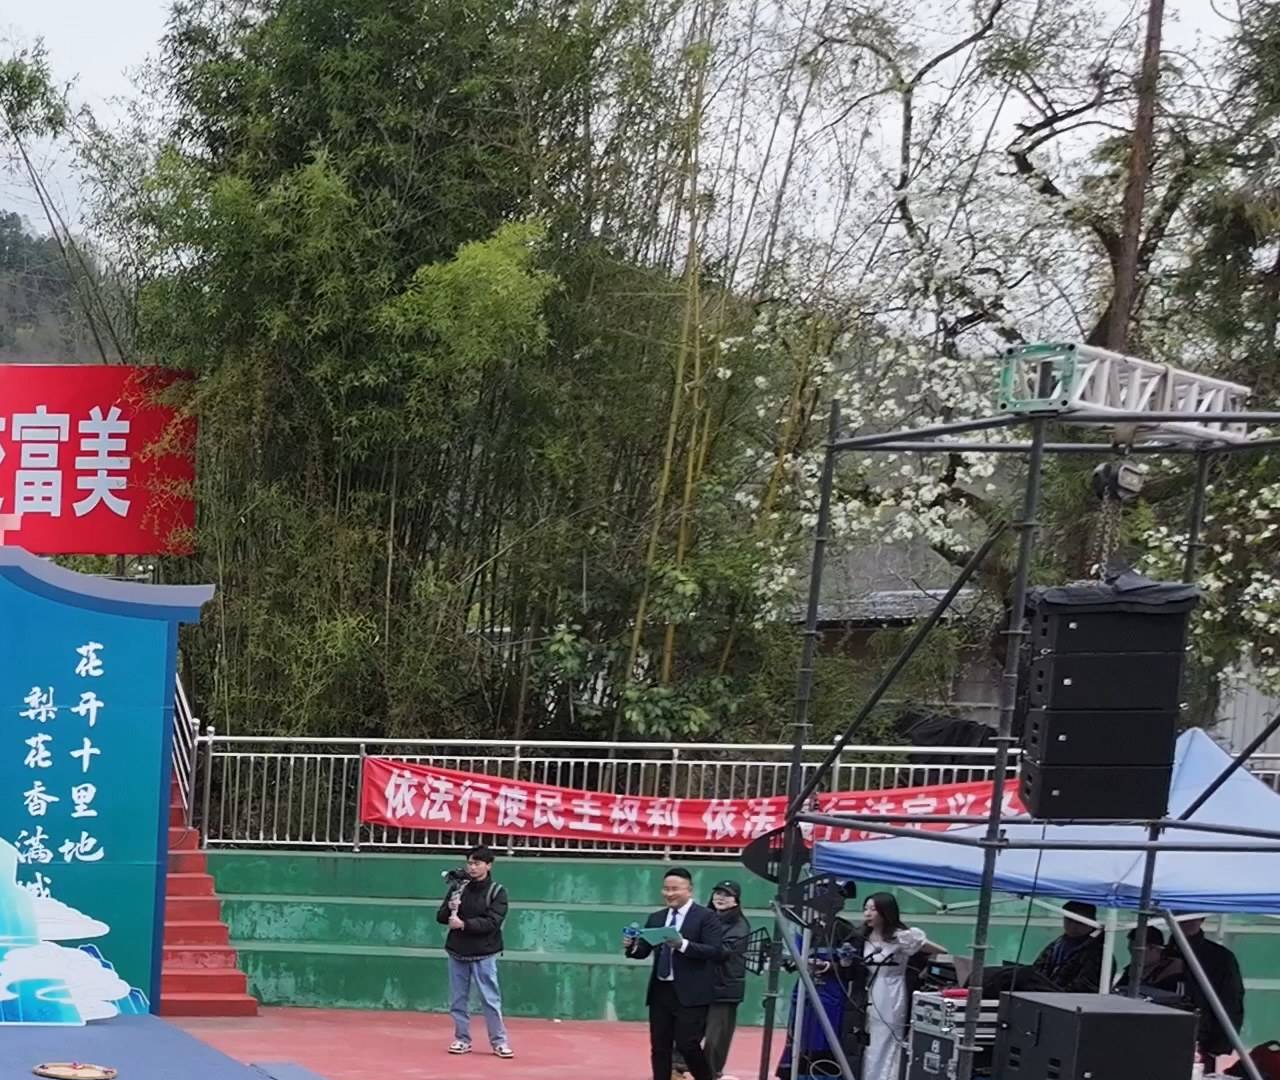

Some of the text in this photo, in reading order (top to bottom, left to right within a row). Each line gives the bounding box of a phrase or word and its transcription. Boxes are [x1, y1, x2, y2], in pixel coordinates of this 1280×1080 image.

[58, 641, 104, 863] 花开十里地
[384, 768, 682, 837] 依法行使民主权利
